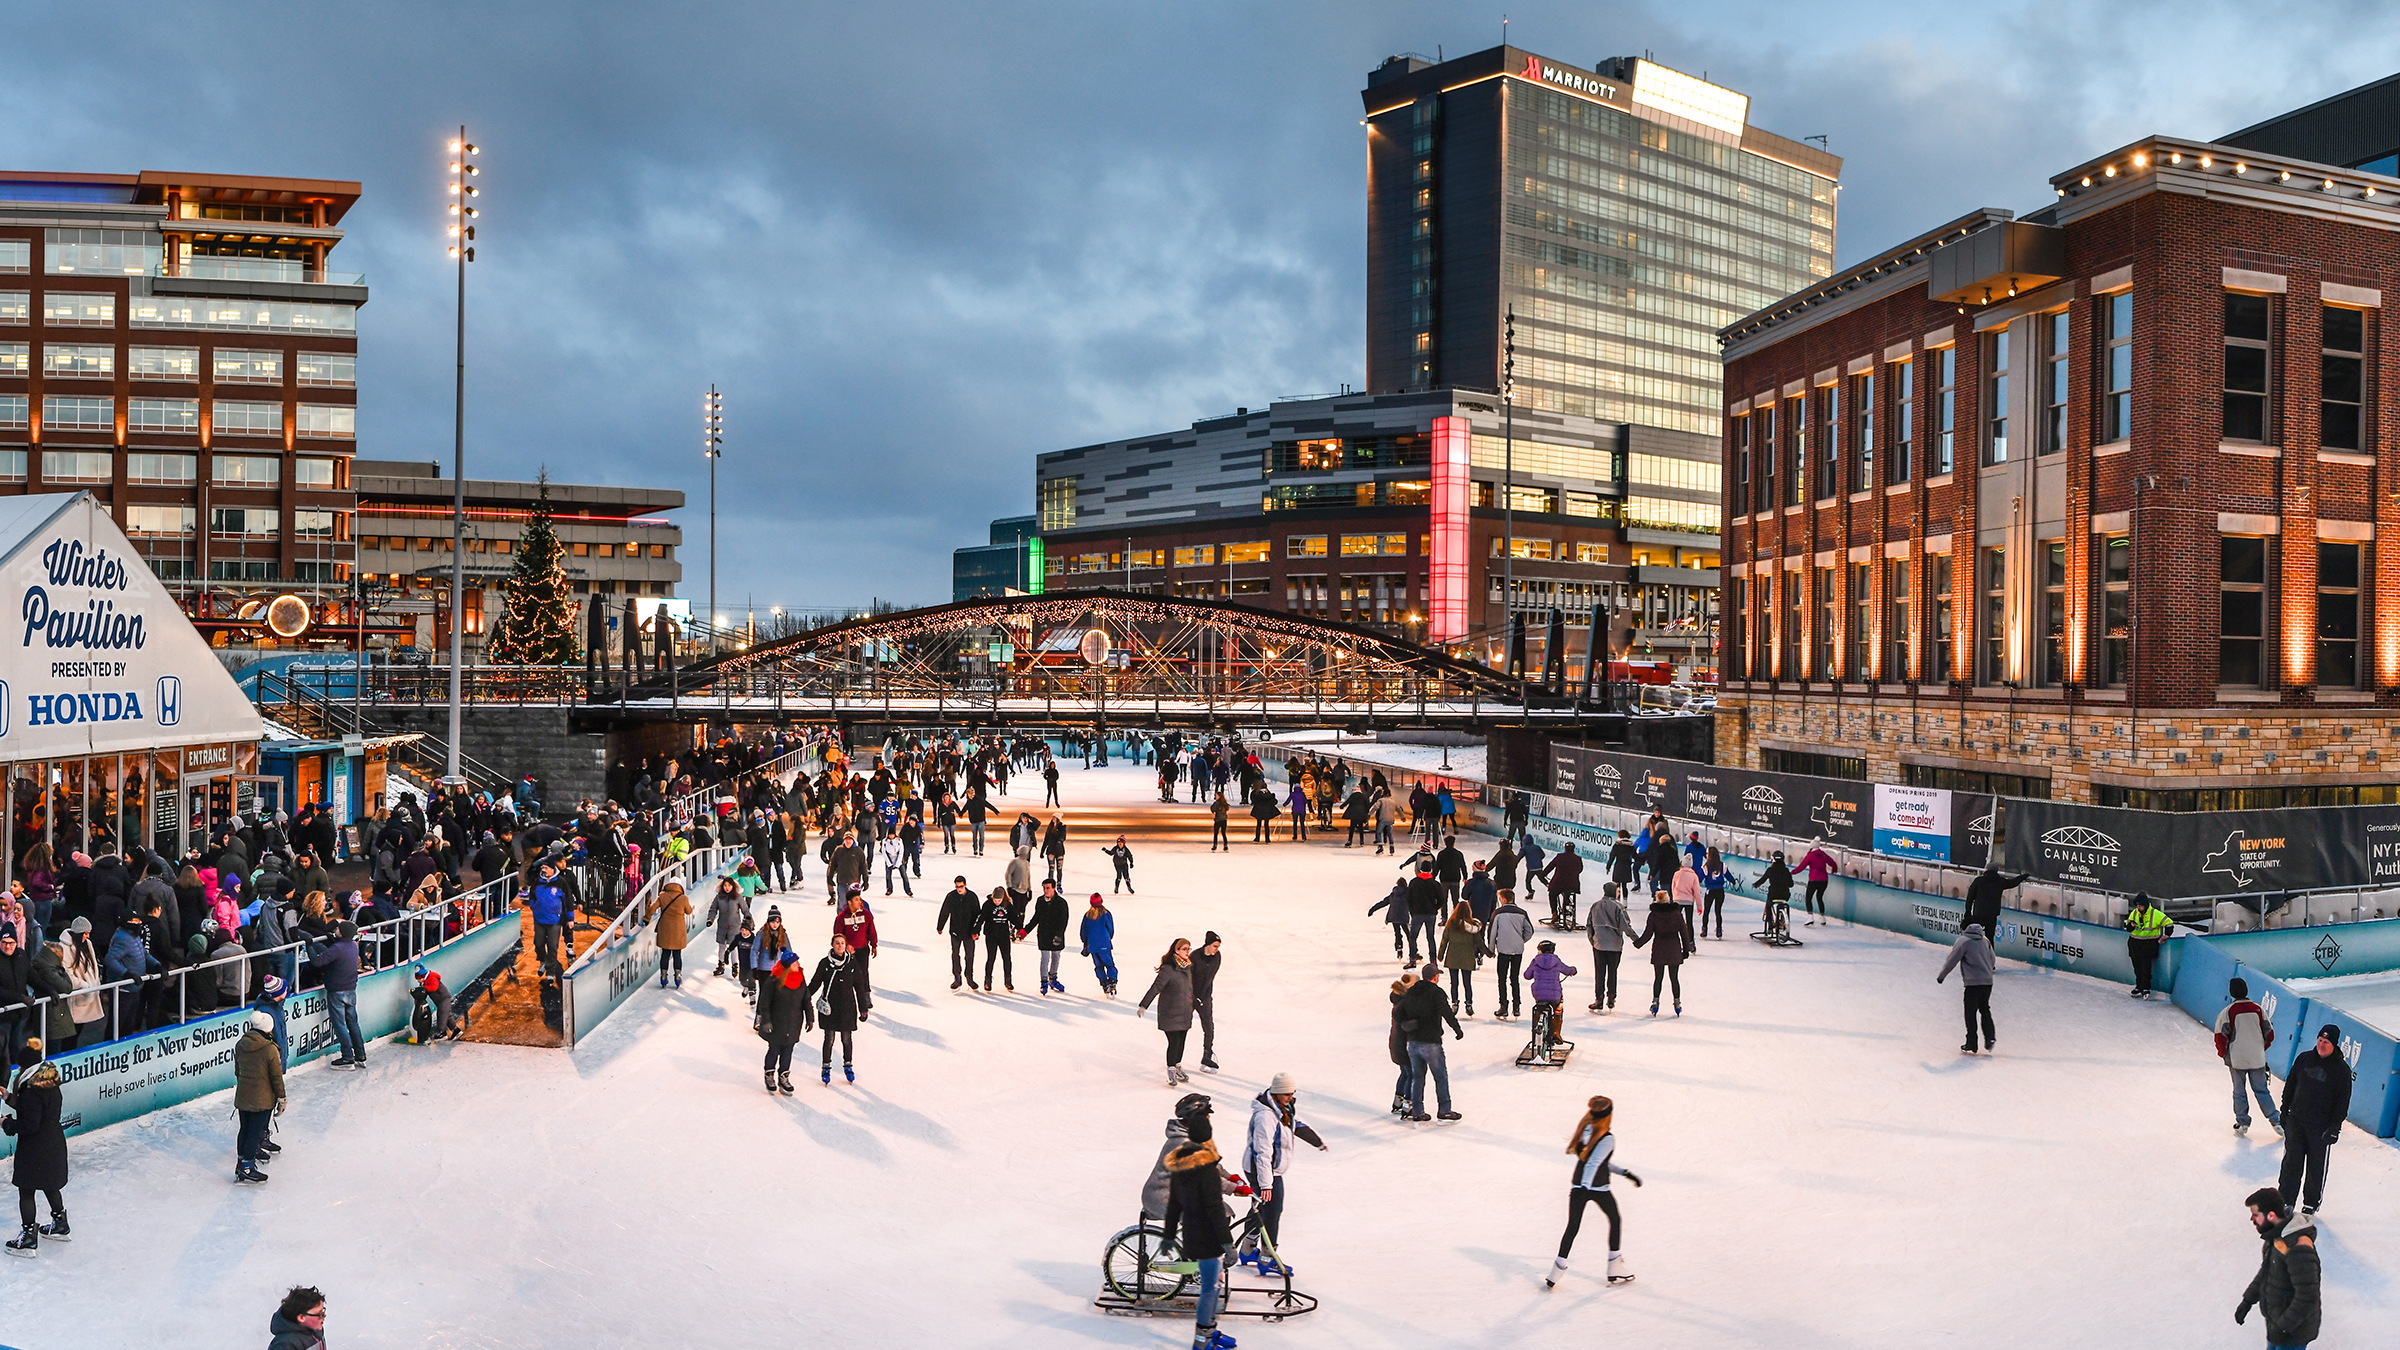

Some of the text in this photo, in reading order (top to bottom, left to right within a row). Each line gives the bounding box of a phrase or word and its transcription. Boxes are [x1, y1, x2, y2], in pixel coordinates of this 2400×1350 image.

[1543, 65, 1616, 100] MARRIOTT
[43, 538, 128, 591] Winter
[23, 585, 146, 650] Pavilion
[51, 661, 127, 678] PRESENTED BY
[28, 692, 143, 726] HONDA
[188, 747, 227, 766] ENTRANCE
[1689, 789, 1718, 804] NY Power
[885, 806, 896, 816] 95
[1689, 803, 1718, 820] Authority
[1743, 802, 1782, 815] CANALSIDE
[1830, 800, 1857, 812] NEW YORK
[1830, 810, 1841, 818] STATE
[1895, 801, 1930, 814] get ready
[1889, 812, 1935, 828] to come play!
[1531, 819, 1538, 829] M
[1543, 823, 1569, 838] CAROLL
[1570, 827, 1613, 847] HARDWOOD
[2240, 837, 2286, 850] NEW YORK
[2373, 843, 2392, 858] NY
[2044, 848, 2118, 867] CANALSIDE
[2240, 852, 2267, 861] STATE OF
[1921, 905, 1939, 918] OFFICIAL
[1939, 909, 1955, 922] HEALTH
[2020, 925, 2044, 938] LIVE
[2027, 937, 2084, 958] FEARLESS
[2314, 946, 2341, 960] CTBK
[608, 961, 624, 1002] THE
[627, 951, 638, 987] ICE
[292, 1001, 302, 1020] &
[60, 1051, 129, 1084] Building
[133, 1044, 154, 1065] for
[157, 1036, 189, 1058] New
[192, 1021, 239, 1049] Stories
[99, 1082, 122, 1100] Help
[124, 1079, 145, 1093] save
[147, 1066, 167, 1085] lives
[168, 1067, 178, 1080] at
